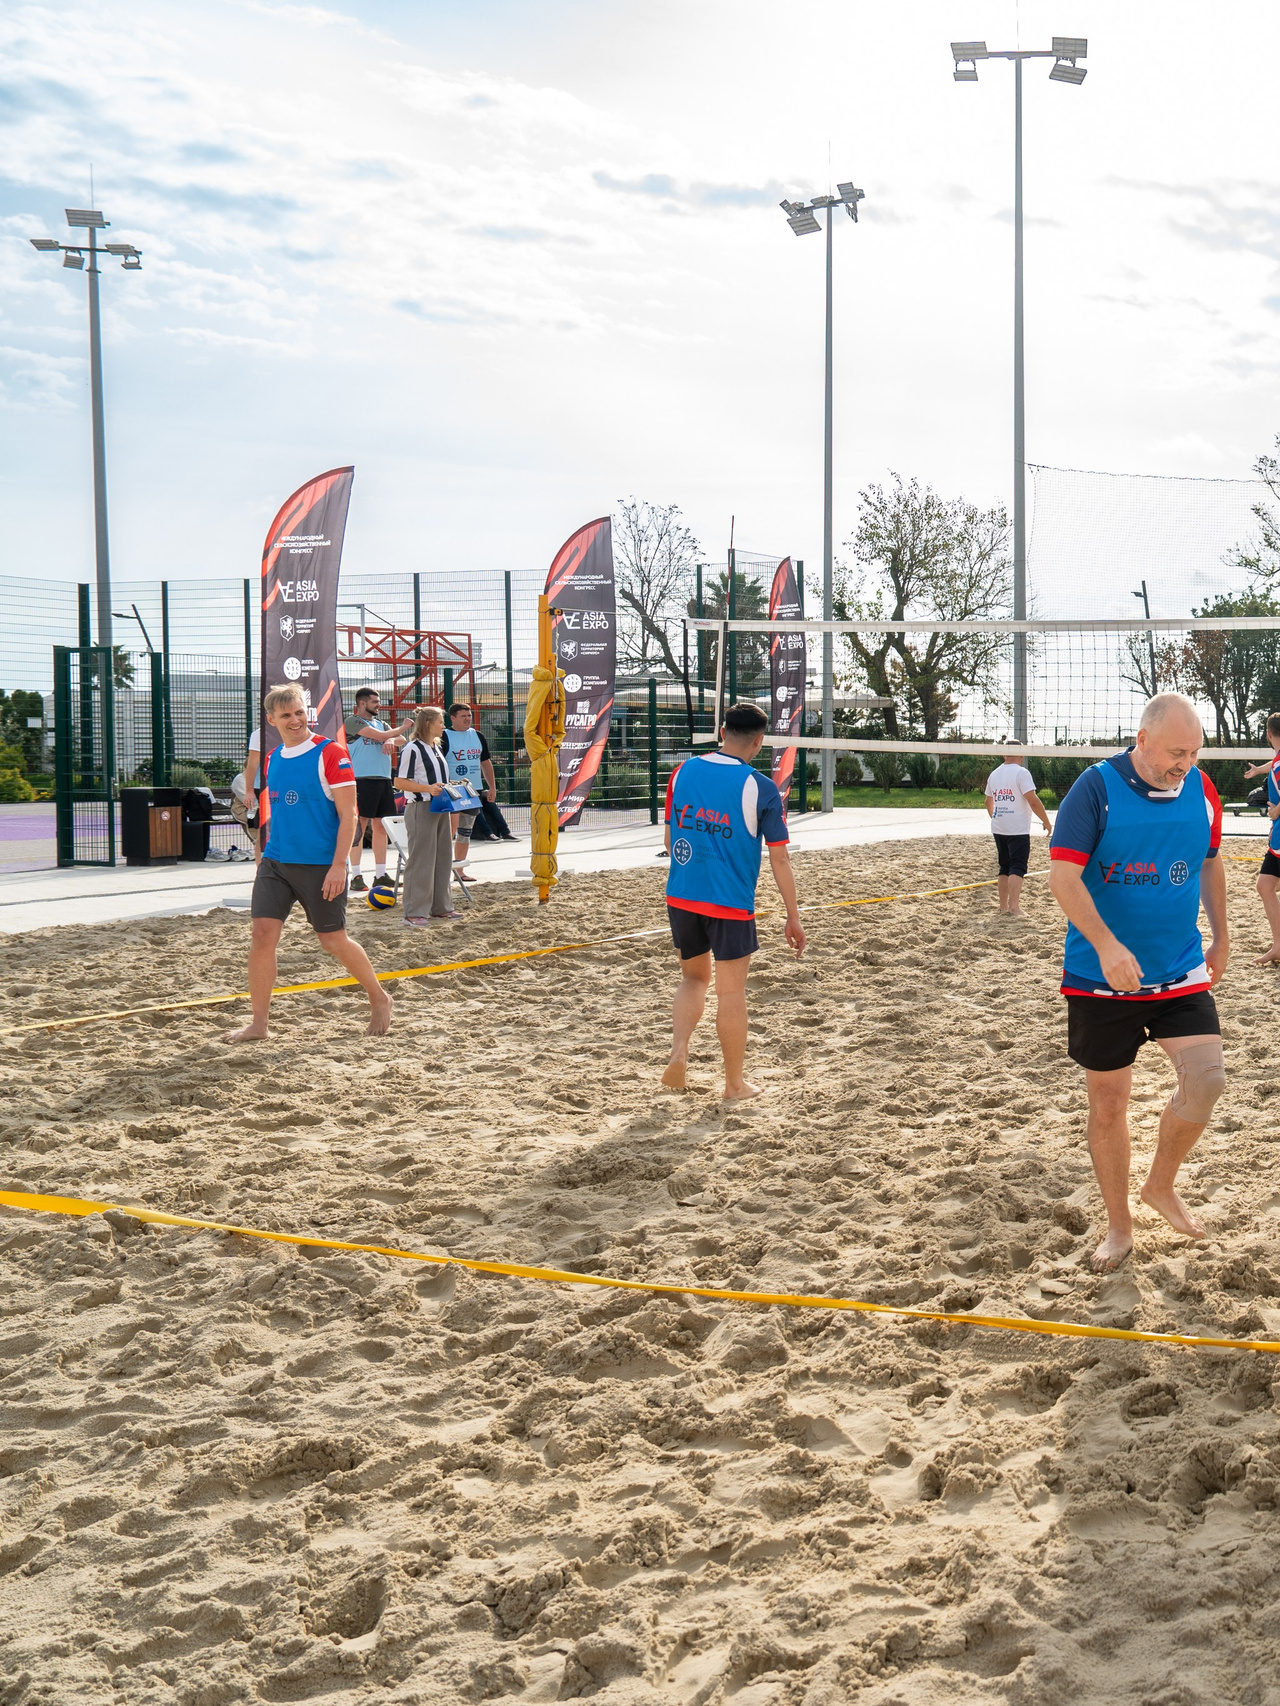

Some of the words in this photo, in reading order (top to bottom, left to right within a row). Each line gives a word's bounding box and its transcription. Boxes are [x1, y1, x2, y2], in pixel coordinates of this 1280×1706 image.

[296, 580, 317, 591] ASIA
[296, 591, 319, 602] EXPO
[583, 612, 606, 621] ASIA
[582, 620, 609, 630] EXPO
[787, 634, 803, 642] ASIA
[787, 641, 804, 650] EXPO
[565, 713, 597, 727] РУСАГРО
[999, 788, 1013, 796] ASIA
[695, 807, 731, 826] ASIA
[696, 819, 733, 839] EXPO
[1124, 862, 1157, 874] ASIA
[1123, 874, 1160, 886] EXPO
